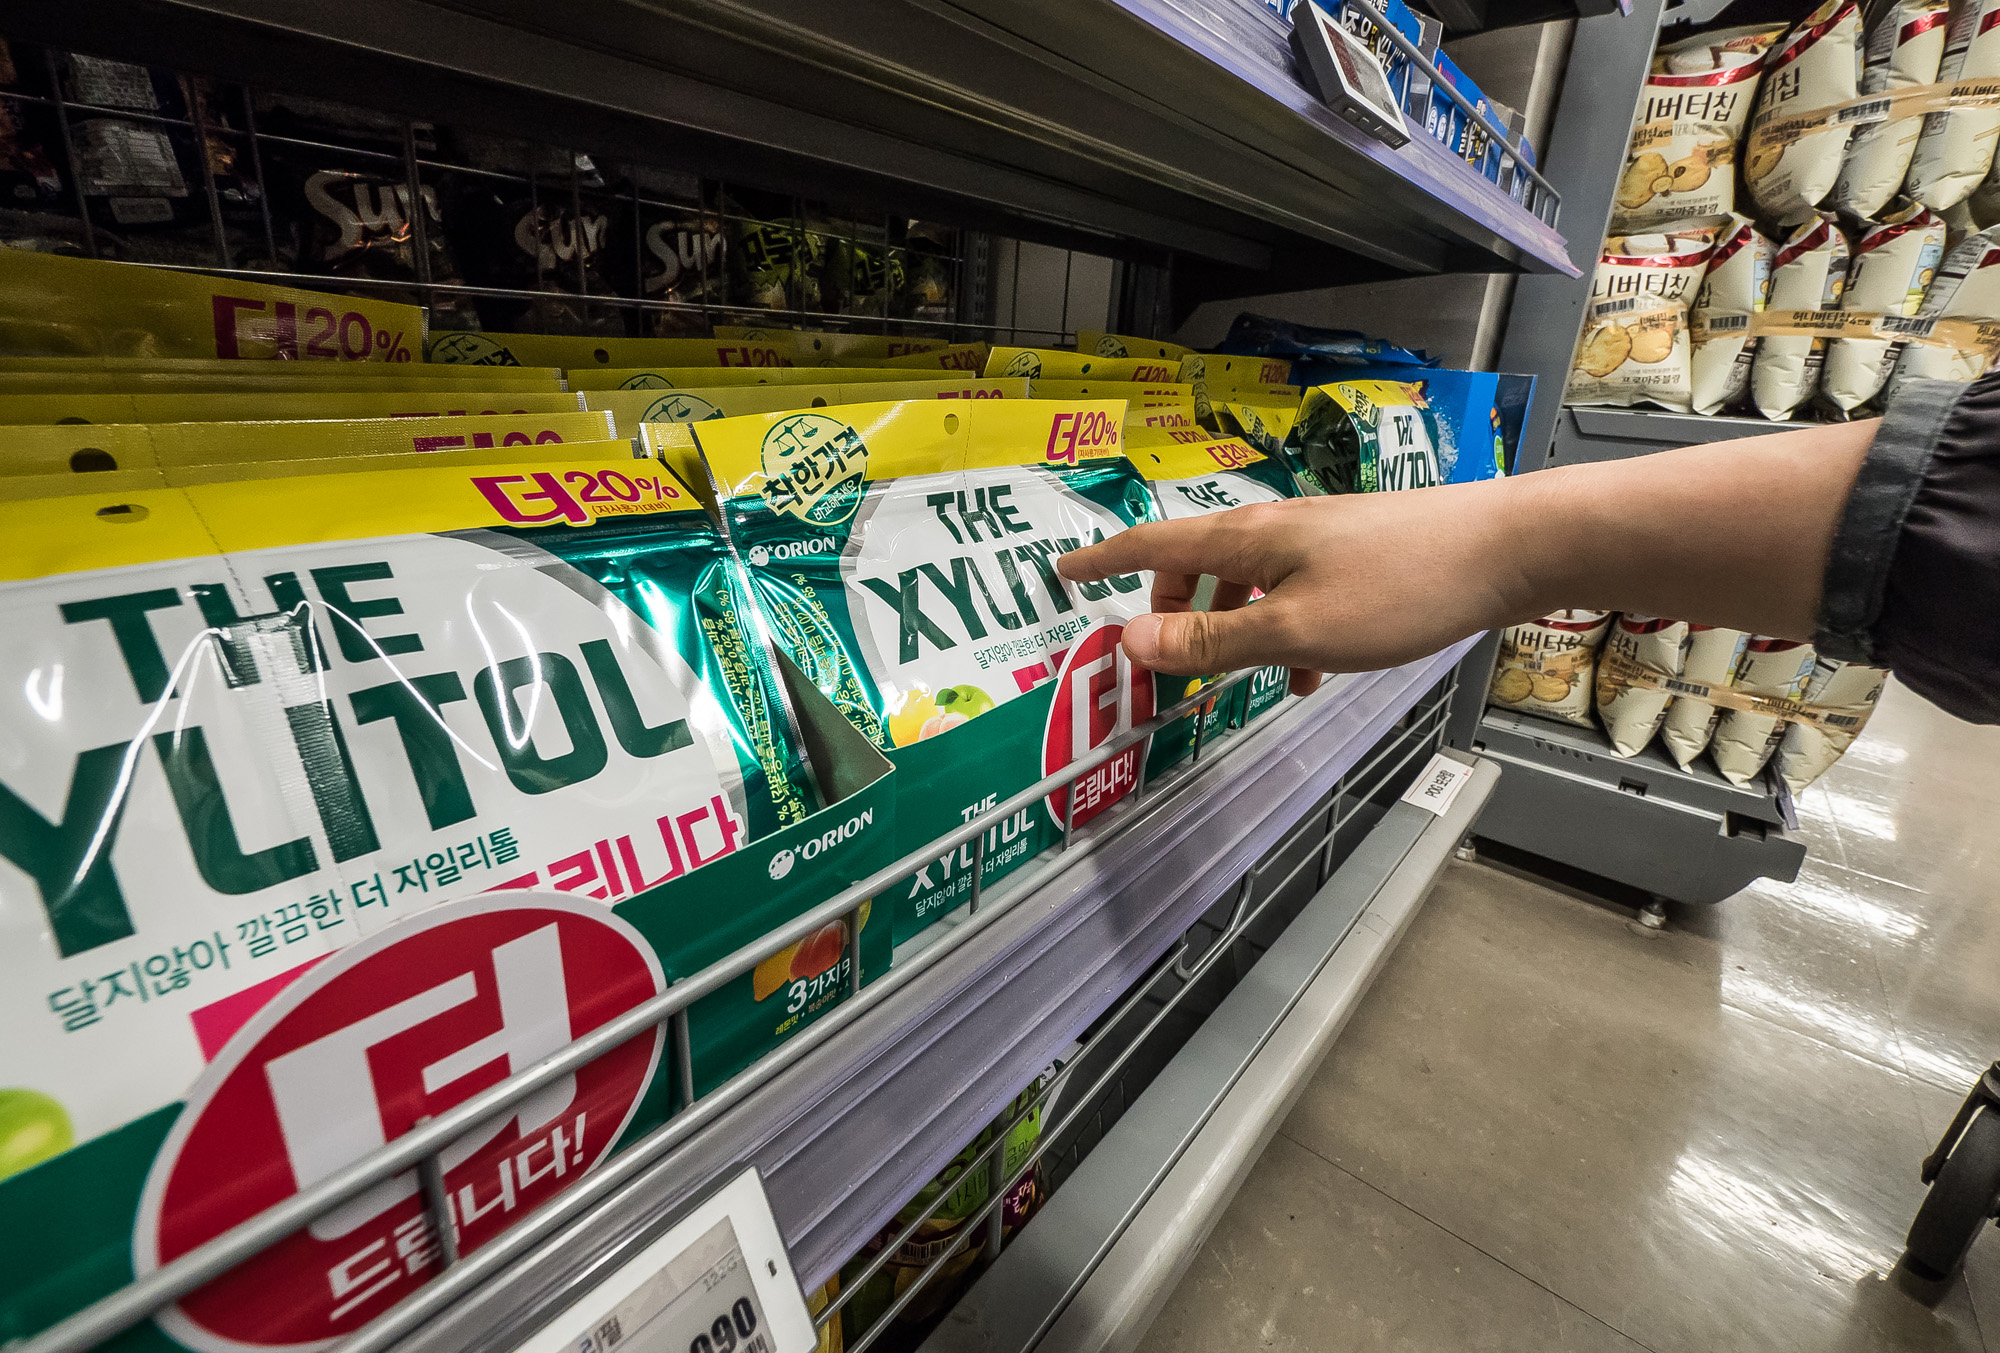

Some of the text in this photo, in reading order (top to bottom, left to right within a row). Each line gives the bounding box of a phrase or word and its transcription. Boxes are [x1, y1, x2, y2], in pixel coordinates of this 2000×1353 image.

[304, 170, 442, 262] Sun
[762, 426, 869, 511] 착한가격
[591, 501, 672, 516] (자사용기대비)
[813, 479, 857, 521] 비교해주세요
[926, 484, 1034, 545] THE
[774, 536, 836, 560] ORION
[801, 584, 816, 600] 65
[60, 561, 425, 705] THE
[722, 609, 736, 624] 65
[1036, 632, 1050, 651] 더
[1424, 784, 1444, 799] POG
[802, 807, 873, 860] ORION
[48, 934, 232, 1032] 달지않아
[236, 891, 343, 959] 깔끔한
[352, 872, 390, 910] 더
[396, 827, 520, 897] 자일리톨
[264, 921, 577, 1243] 더
